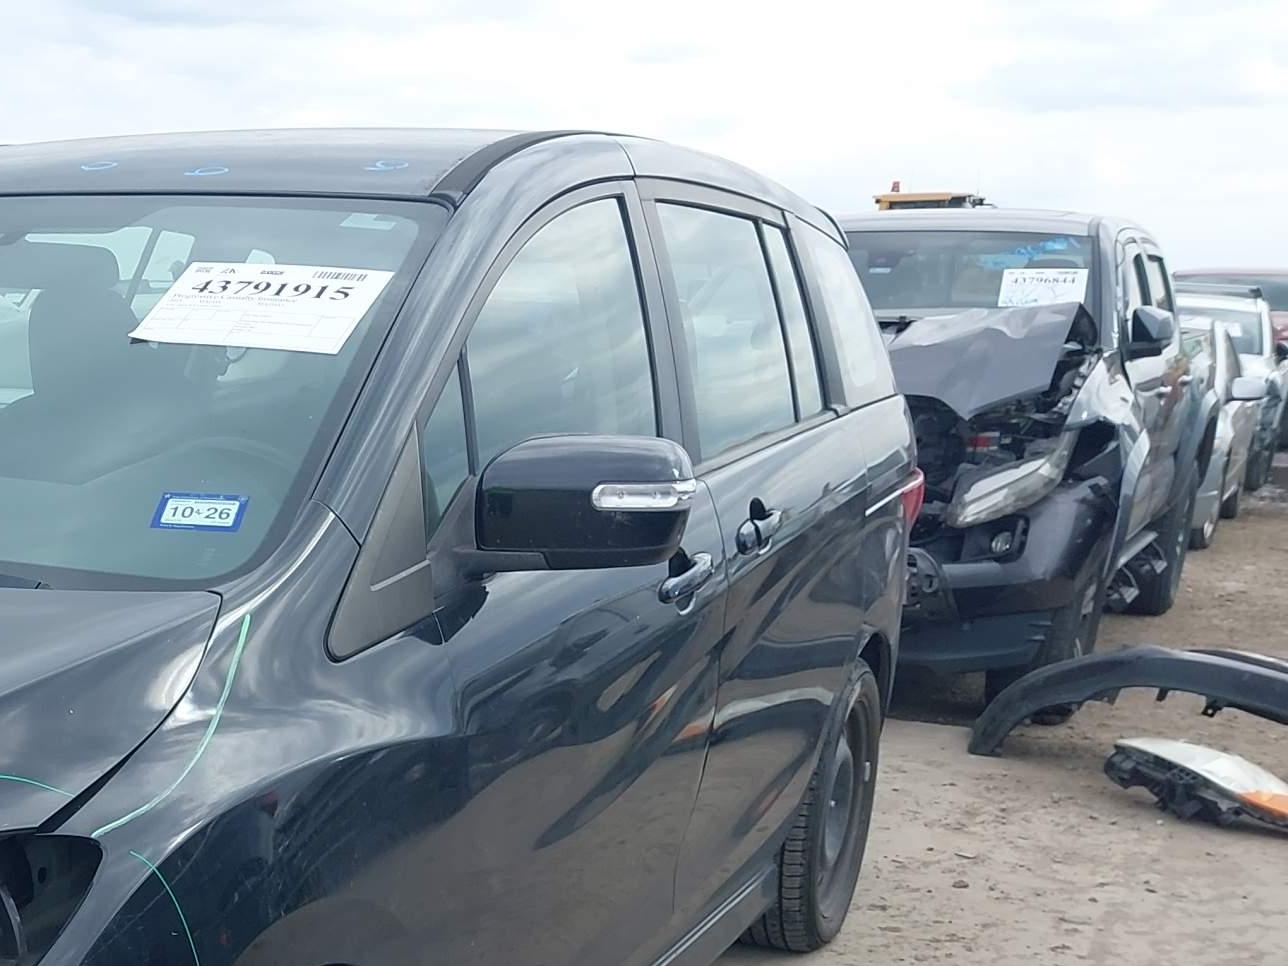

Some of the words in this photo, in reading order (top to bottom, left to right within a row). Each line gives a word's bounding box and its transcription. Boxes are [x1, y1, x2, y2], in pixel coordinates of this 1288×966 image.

[191, 279, 355, 301] 43791915
[169, 506, 195, 519] 10
[203, 507, 233, 520] 26
